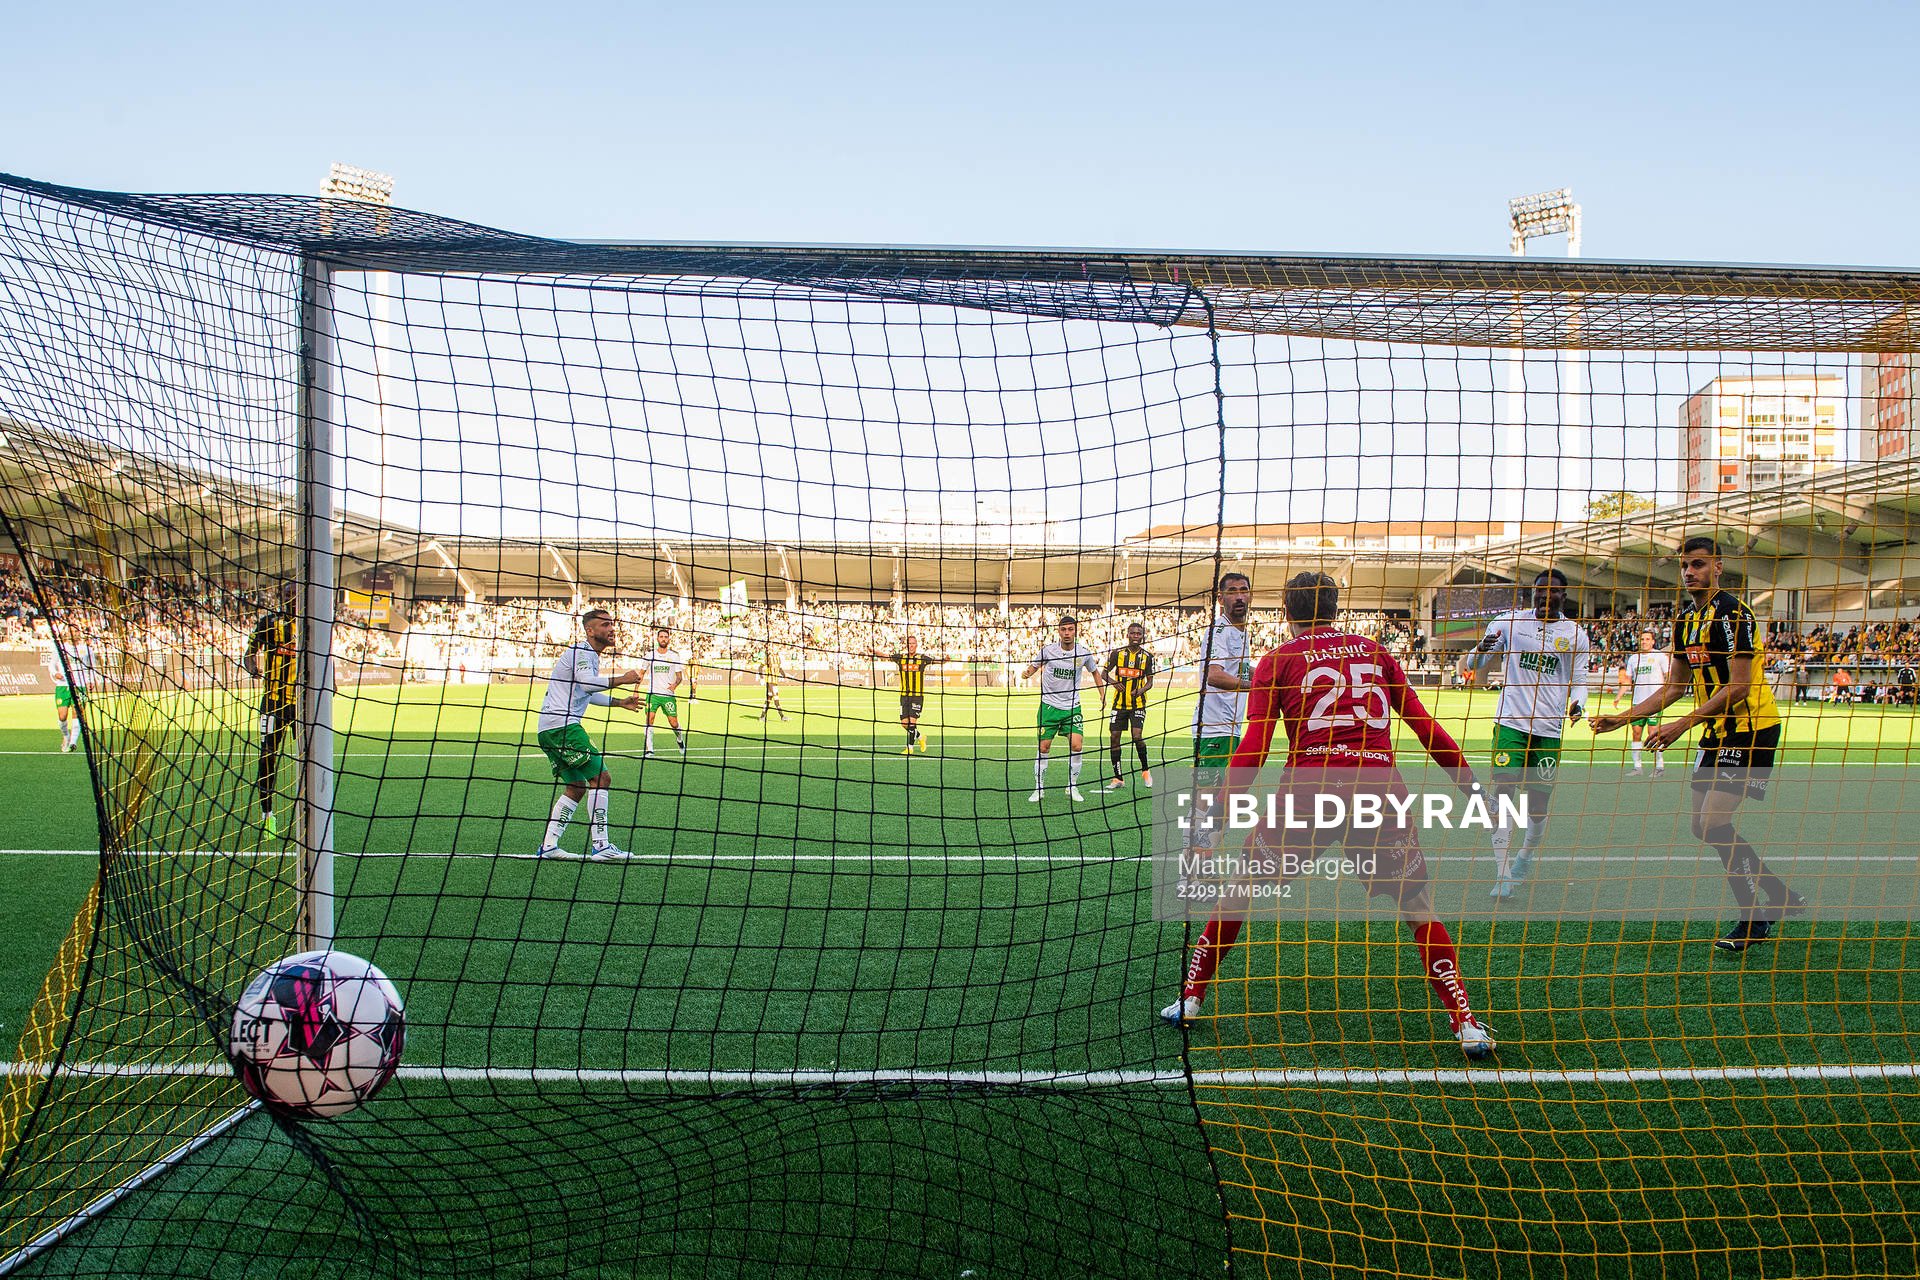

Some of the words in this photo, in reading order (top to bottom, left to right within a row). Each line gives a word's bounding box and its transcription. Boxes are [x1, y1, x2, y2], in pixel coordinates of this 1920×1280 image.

[1303, 642, 1370, 663] BLAŽEVIĆ
[1053, 667, 1076, 677] HUSK
[1301, 663, 1390, 732] 25
